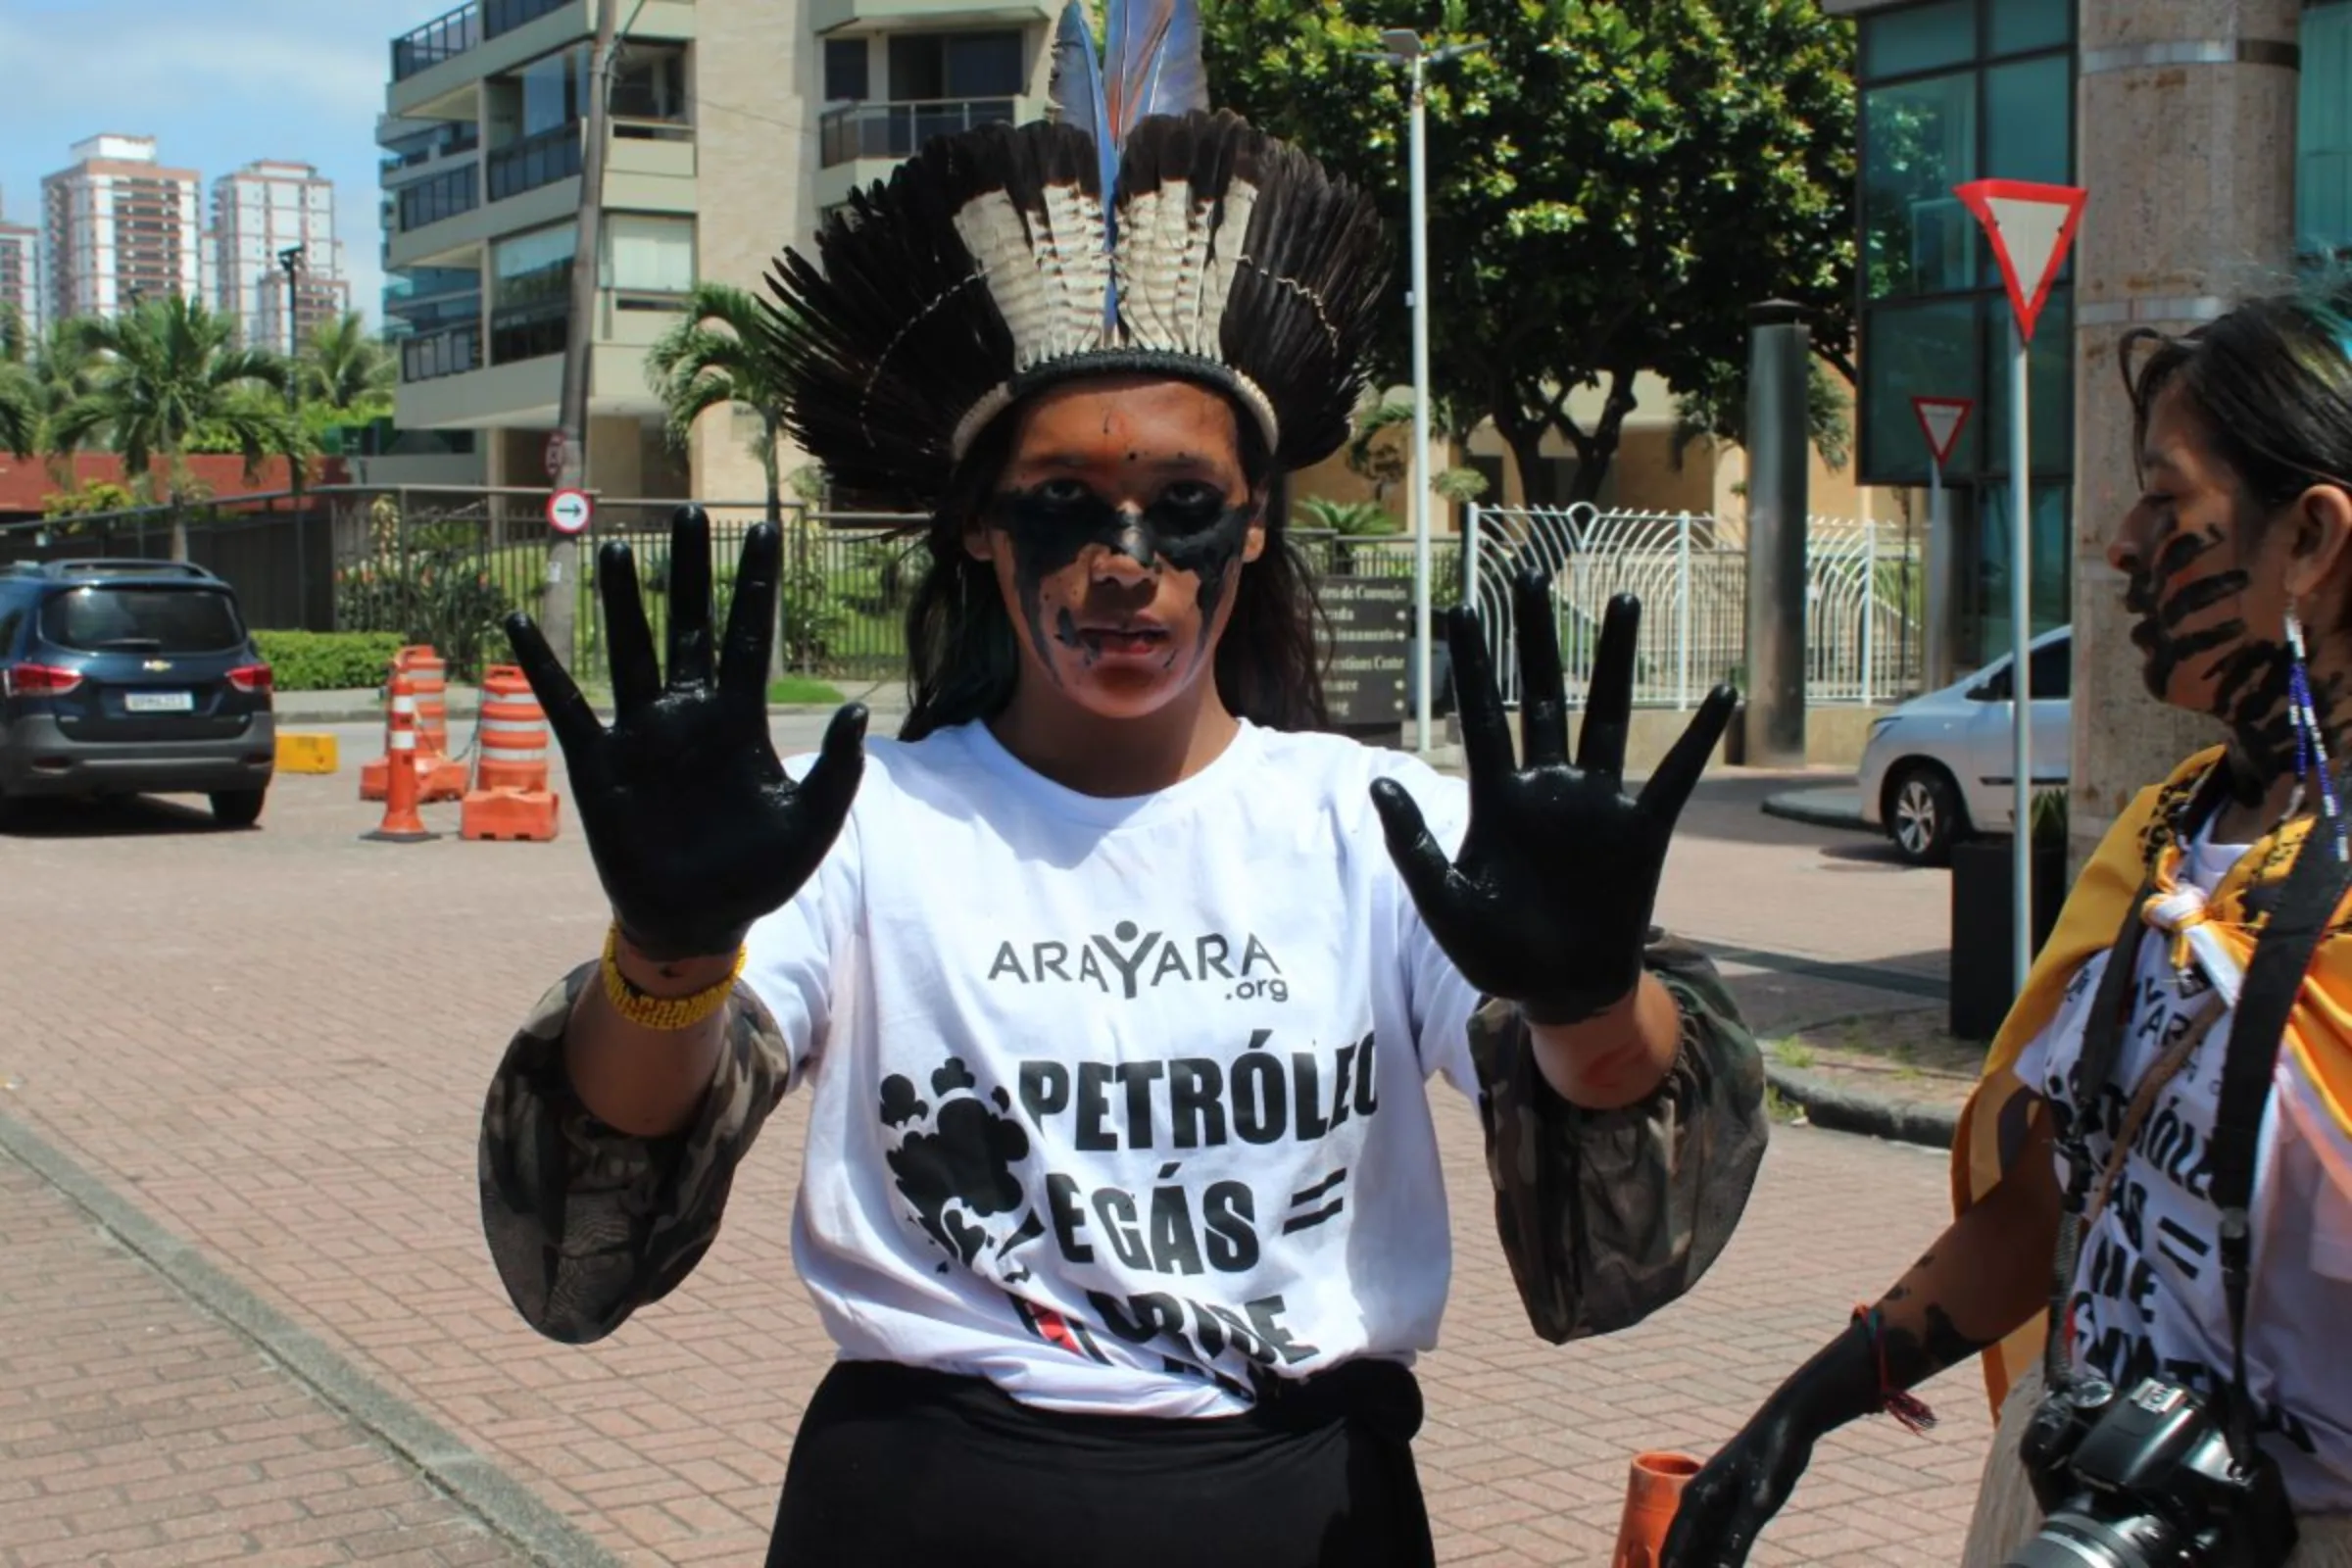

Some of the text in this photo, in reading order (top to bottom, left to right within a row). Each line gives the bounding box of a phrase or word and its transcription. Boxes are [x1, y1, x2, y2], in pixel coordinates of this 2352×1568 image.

[988, 921, 1281, 1000] ARAYARA
[1225, 978, 1289, 1003] .org
[1019, 1029, 1379, 1152] PETRÓLEO
